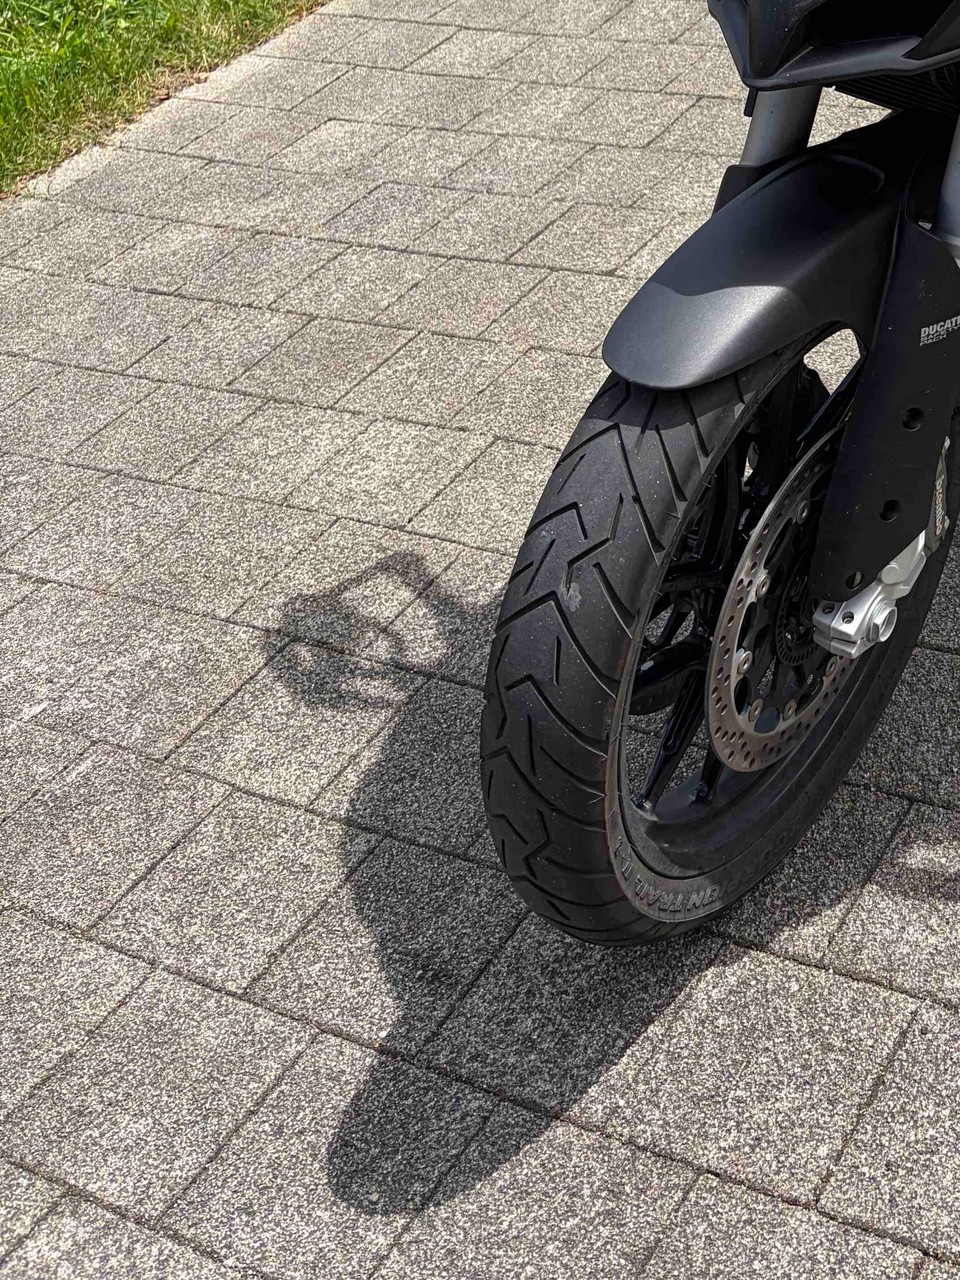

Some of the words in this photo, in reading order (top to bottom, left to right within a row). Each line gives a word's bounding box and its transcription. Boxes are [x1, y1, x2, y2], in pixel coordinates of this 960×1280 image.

[920, 315, 960, 338] DUCATI
[935, 473, 945, 536] brembo
[634, 875, 685, 913] TRAIL
